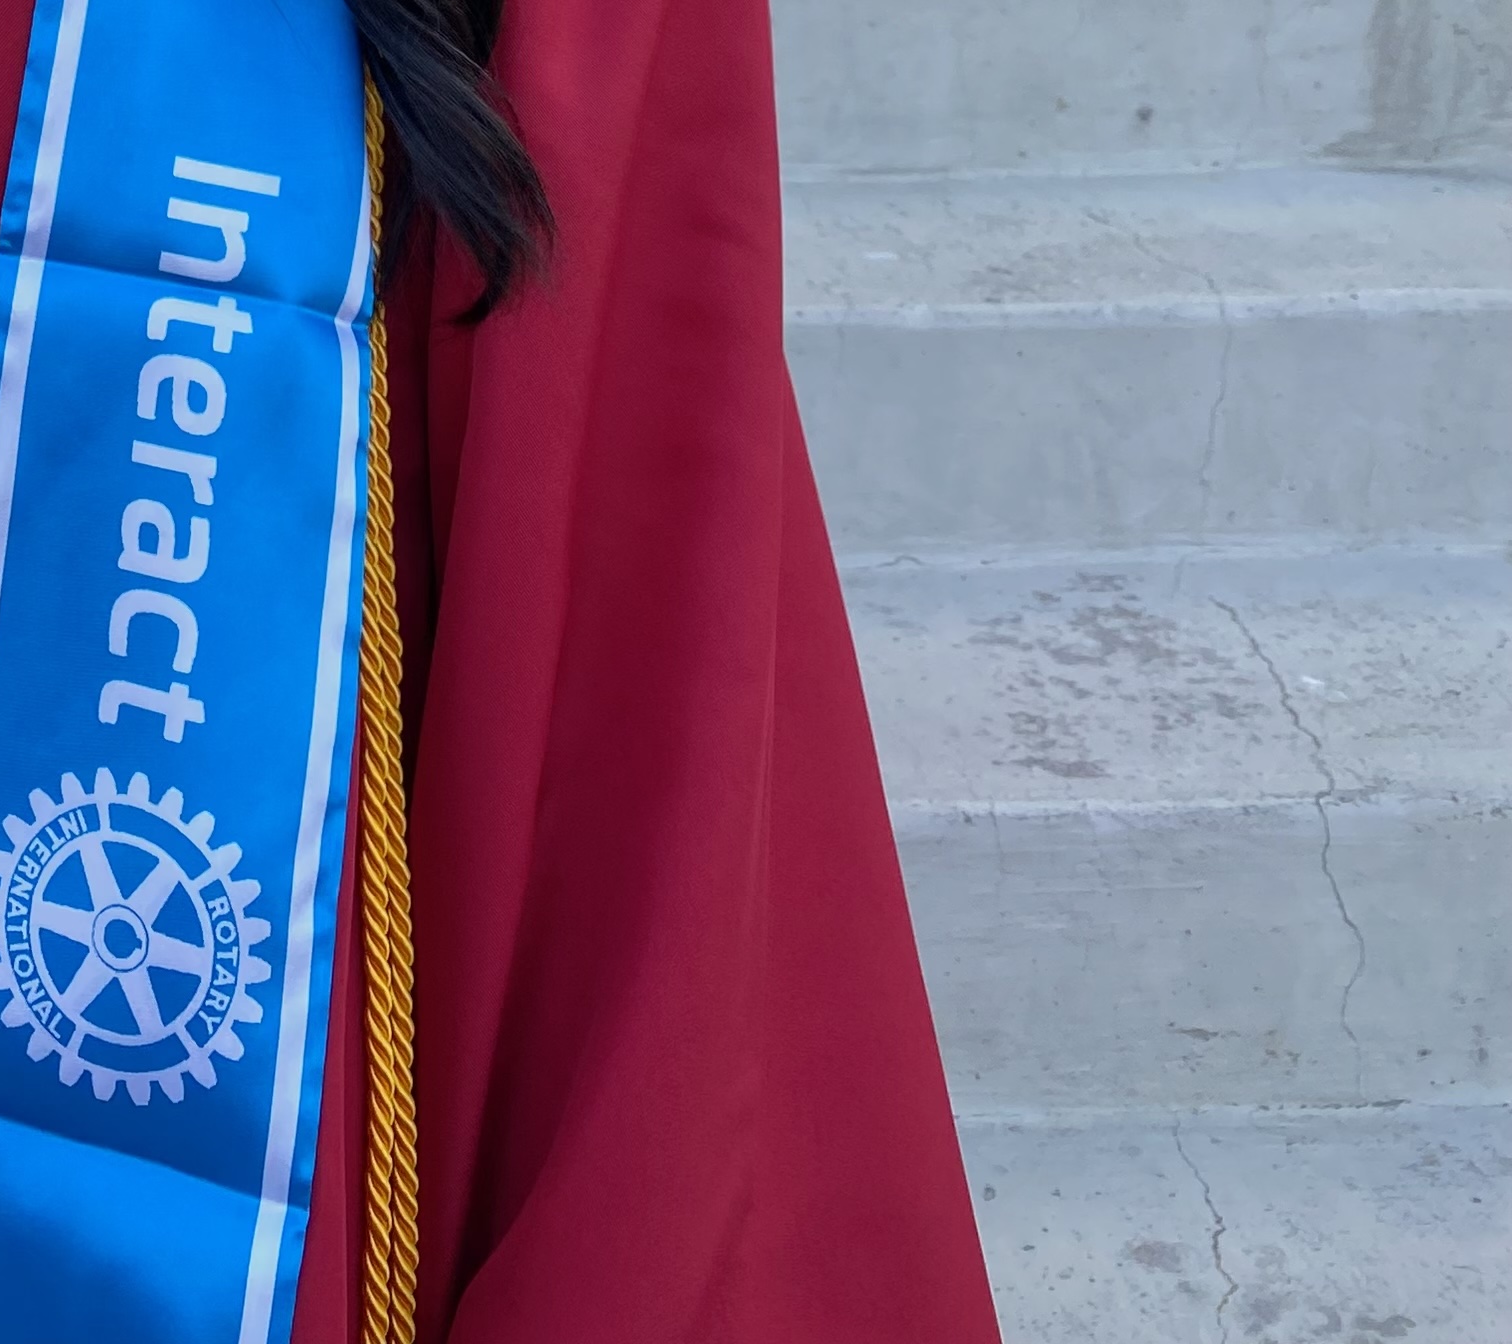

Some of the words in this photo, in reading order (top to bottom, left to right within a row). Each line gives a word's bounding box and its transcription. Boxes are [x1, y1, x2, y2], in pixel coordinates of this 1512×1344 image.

[98, 155, 282, 744] Interact
[5, 808, 89, 1039] INTERNATIONAL
[198, 894, 239, 1036] ROTARY
